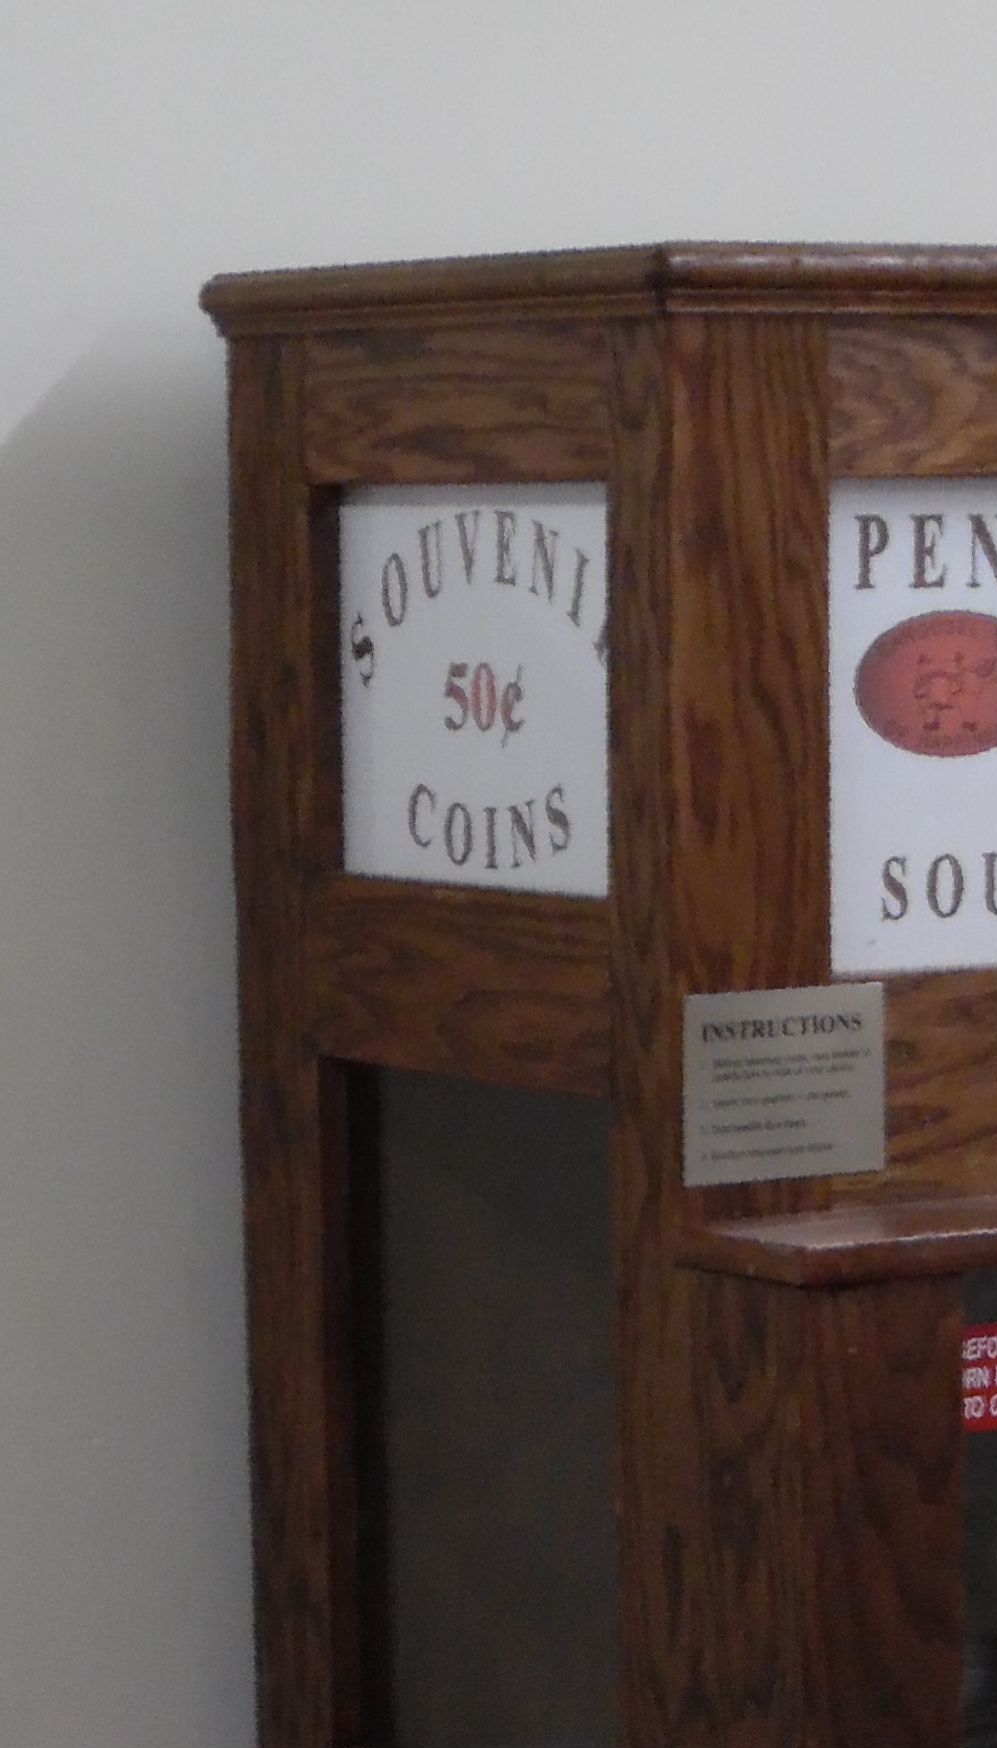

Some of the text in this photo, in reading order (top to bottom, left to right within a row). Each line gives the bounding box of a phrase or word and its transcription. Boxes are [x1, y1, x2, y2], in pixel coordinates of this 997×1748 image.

[444, 663, 524, 748] 50¢
[408, 784, 572, 870] COINS
[702, 1012, 863, 1042] INSTRUCTIONS
[963, 1396, 984, 1420] TO
